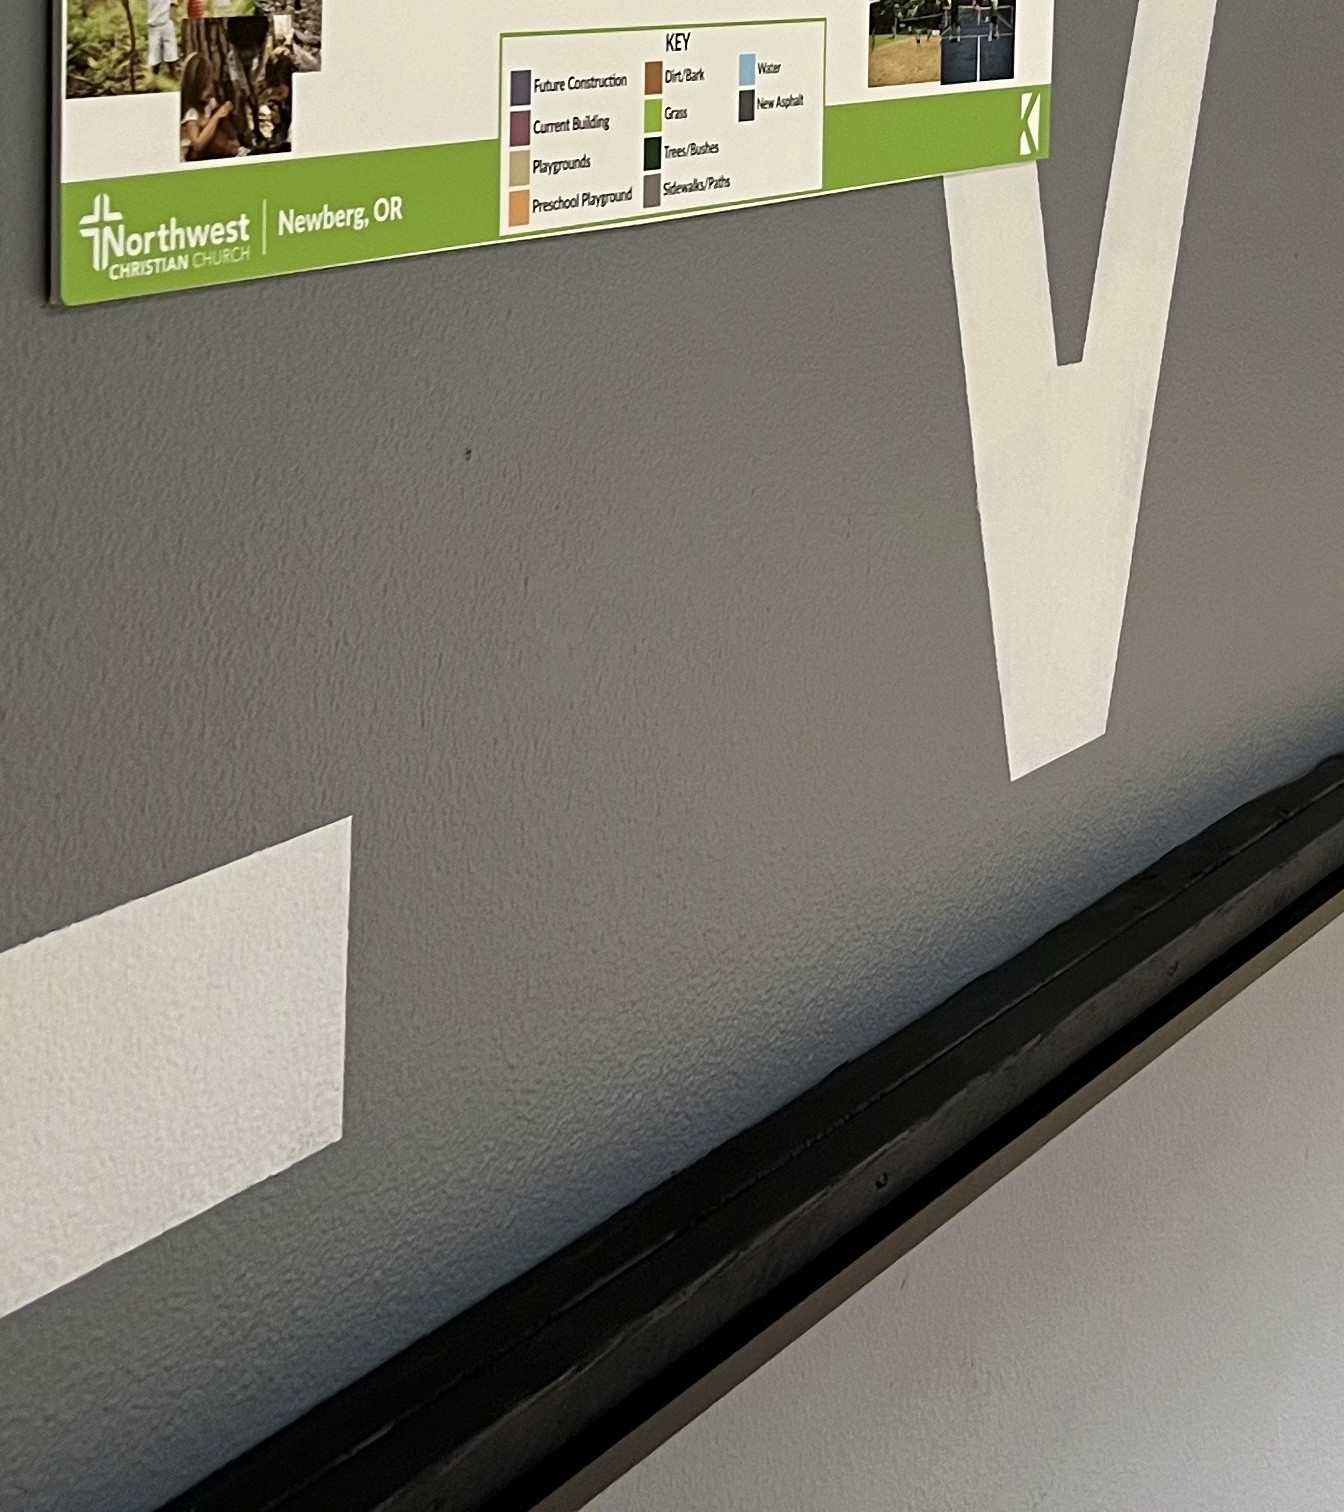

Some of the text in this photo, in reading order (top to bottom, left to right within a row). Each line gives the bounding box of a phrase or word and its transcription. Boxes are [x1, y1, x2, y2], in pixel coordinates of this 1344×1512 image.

[665, 33, 690, 52] KEY
[665, 66, 705, 85] Dirt/Bark
[758, 61, 781, 75] Water
[533, 74, 627, 93] Future Construction
[756, 94, 804, 110] New Asphalt
[664, 105, 688, 122] Grass
[533, 114, 610, 136] Current Building
[664, 140, 719, 159] Trees/Bushes
[532, 153, 591, 175] Playgrounds
[663, 174, 731, 197] Sidewalks/Paths
[532, 188, 632, 214] Preschool Playground
[278, 196, 403, 236] Newberg, OR
[106, 214, 250, 257] Northwest
[109, 245, 250, 280] CHRISTIAN CHURCH
